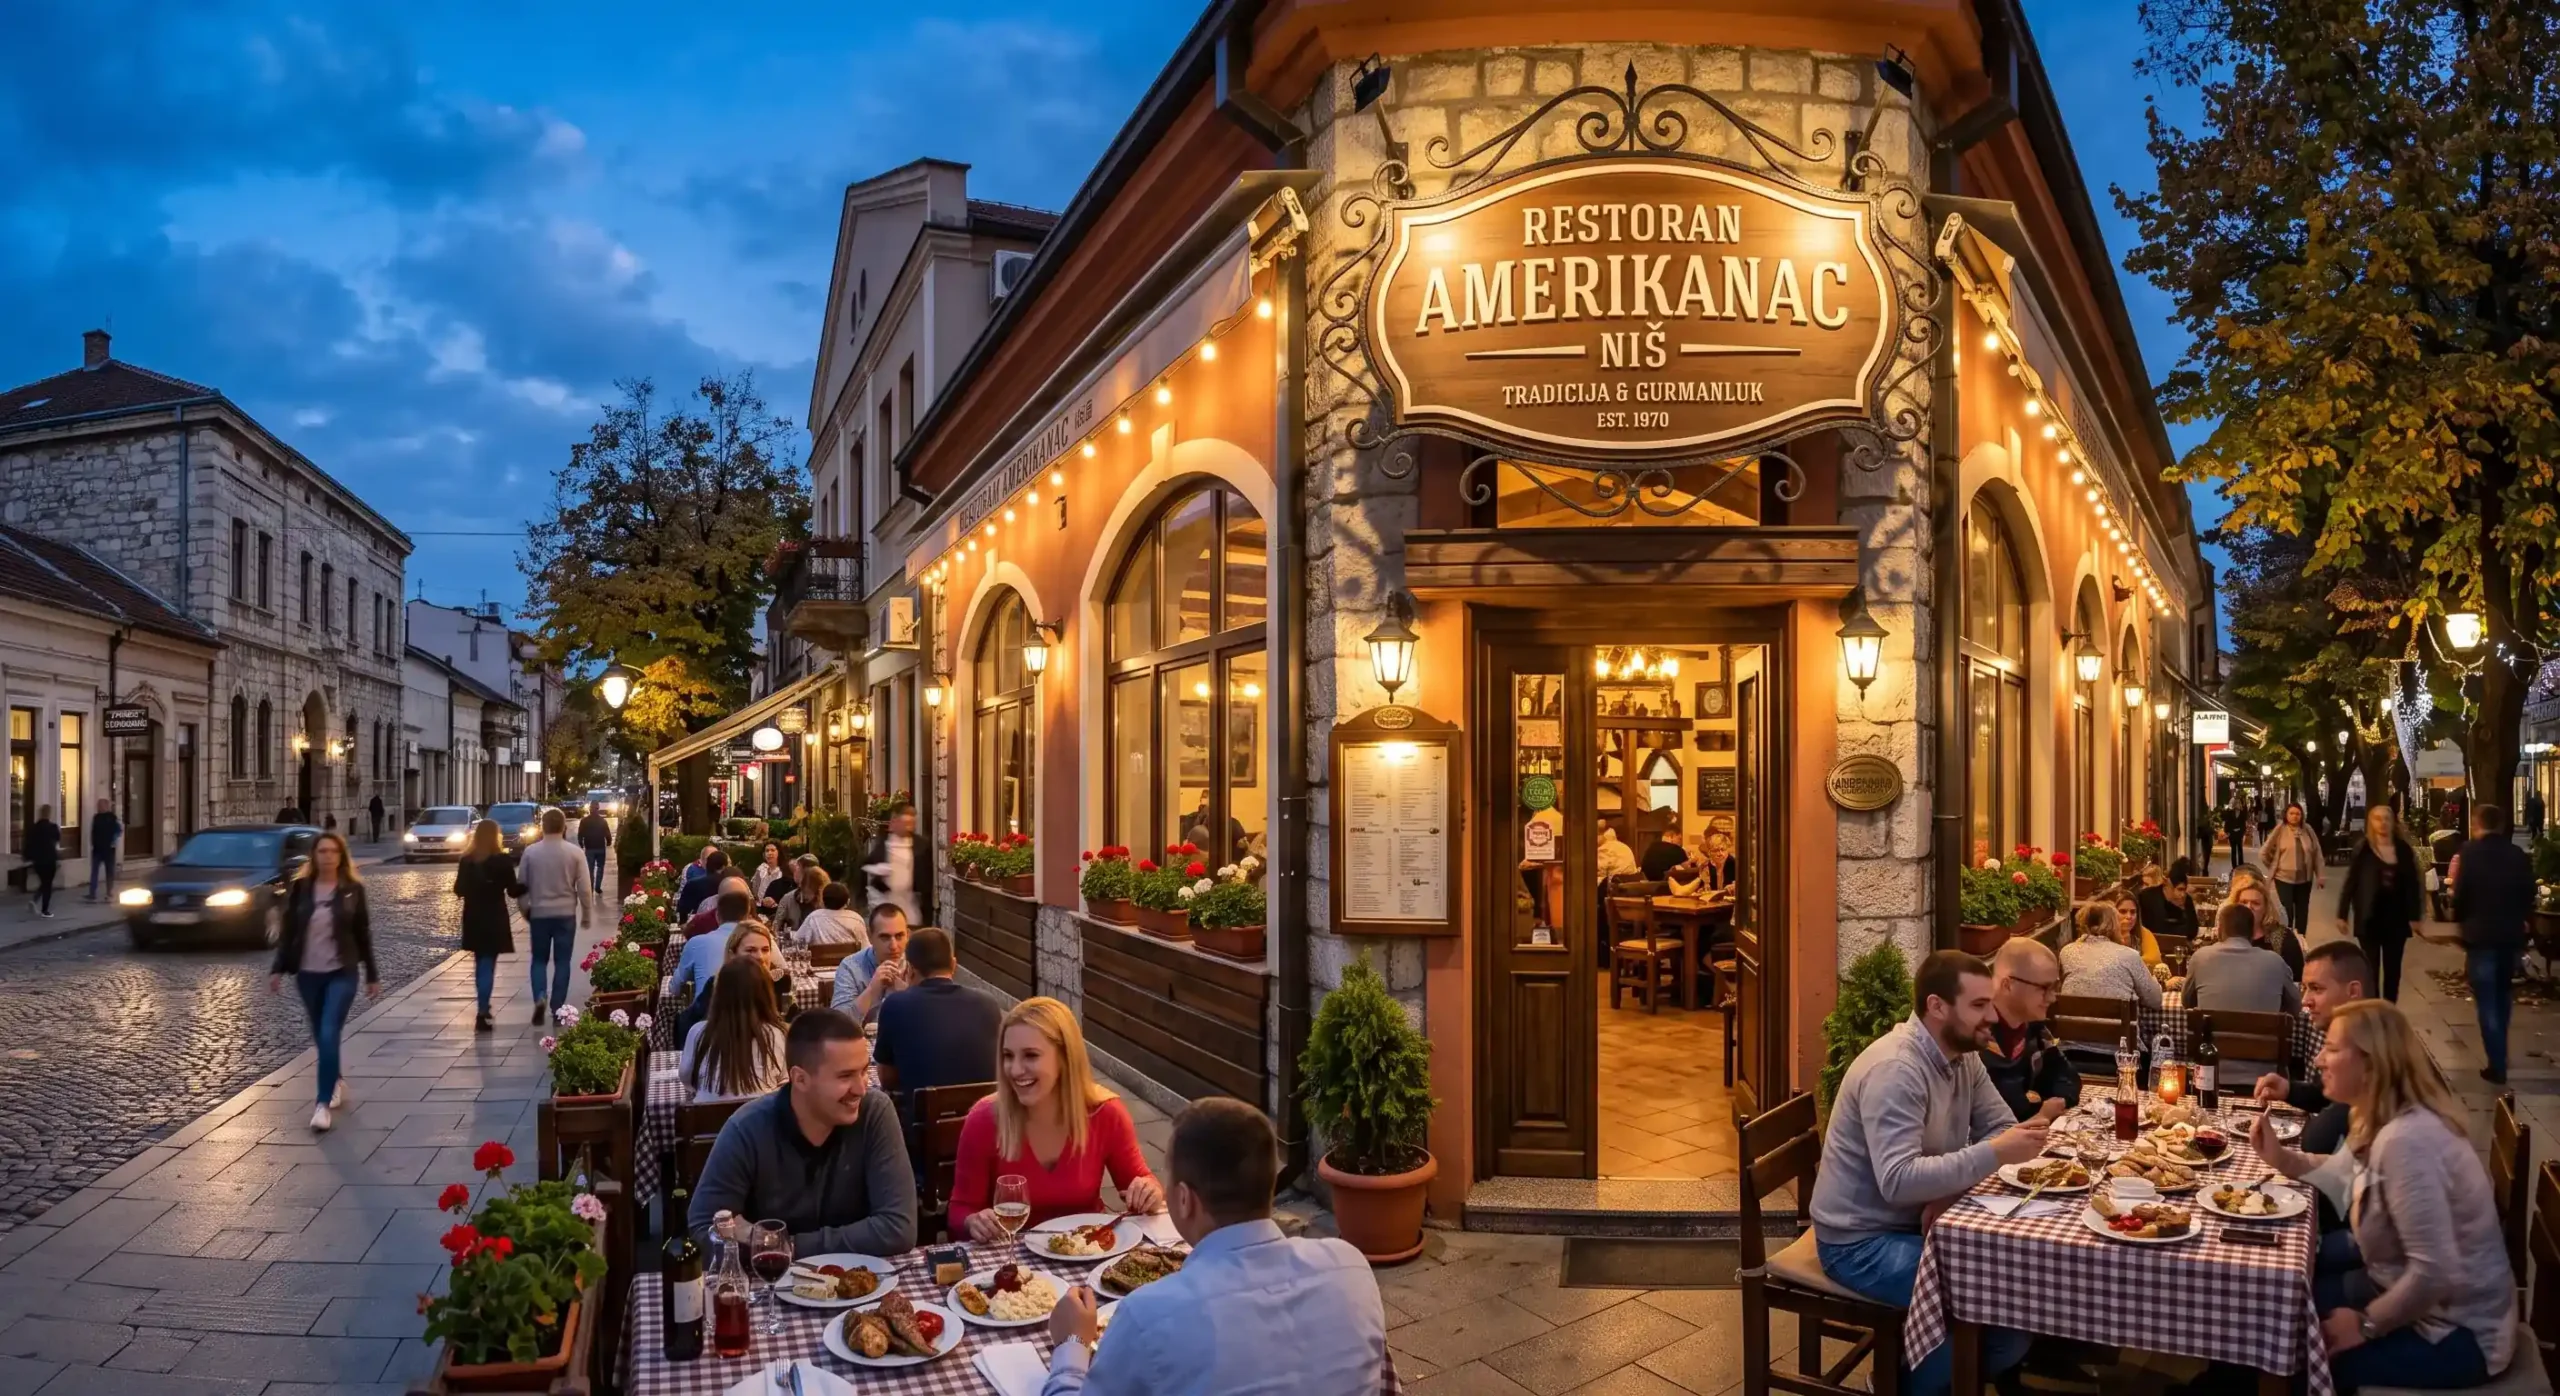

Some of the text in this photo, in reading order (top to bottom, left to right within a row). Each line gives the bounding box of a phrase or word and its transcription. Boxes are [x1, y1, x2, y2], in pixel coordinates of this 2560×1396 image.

[1522, 203, 1742, 245] RESTORAN
[1414, 253, 1849, 334] AMERIKANAC
[1600, 322, 1668, 369] NIŠ
[1502, 381, 1765, 405] TRADICIJA & GURMANLUK
[1597, 411, 1670, 428] EST. 1970
